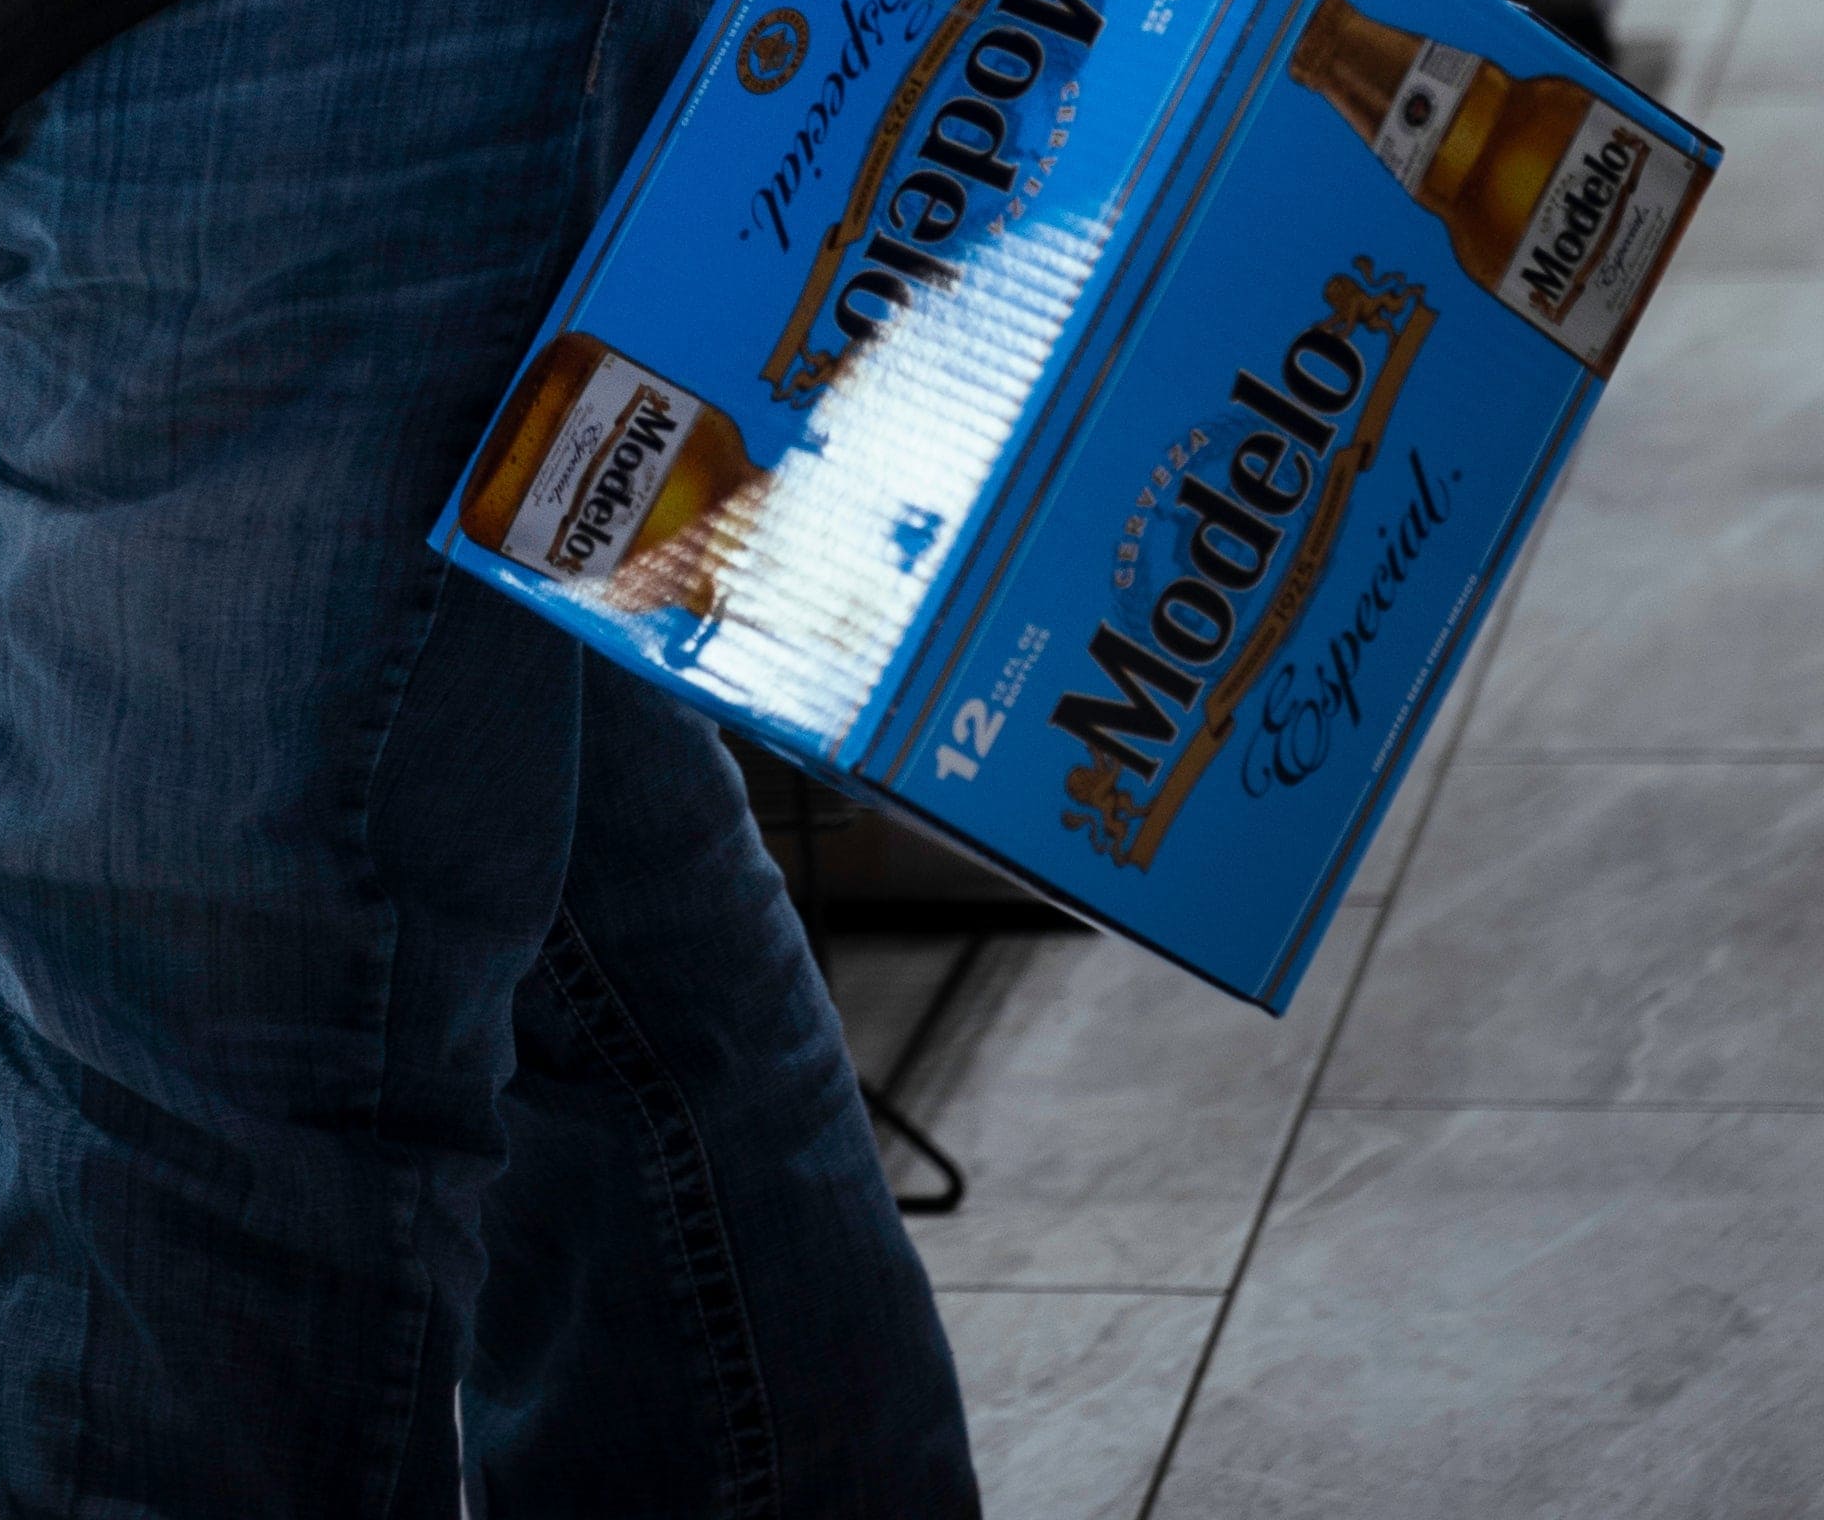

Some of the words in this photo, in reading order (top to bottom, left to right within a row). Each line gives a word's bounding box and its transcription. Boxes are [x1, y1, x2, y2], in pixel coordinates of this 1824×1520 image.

[880, 76, 924, 138] 1925
[984, 81, 1081, 238] CERVEZA
[1523, 138, 1631, 301] Modelo
[564, 405, 677, 562] Modelo
[1049, 326, 1365, 783] Modelo
[1109, 426, 1211, 586] CERVEZA
[1244, 449, 1461, 798] Especial.
[937, 695, 1006, 783] 12
